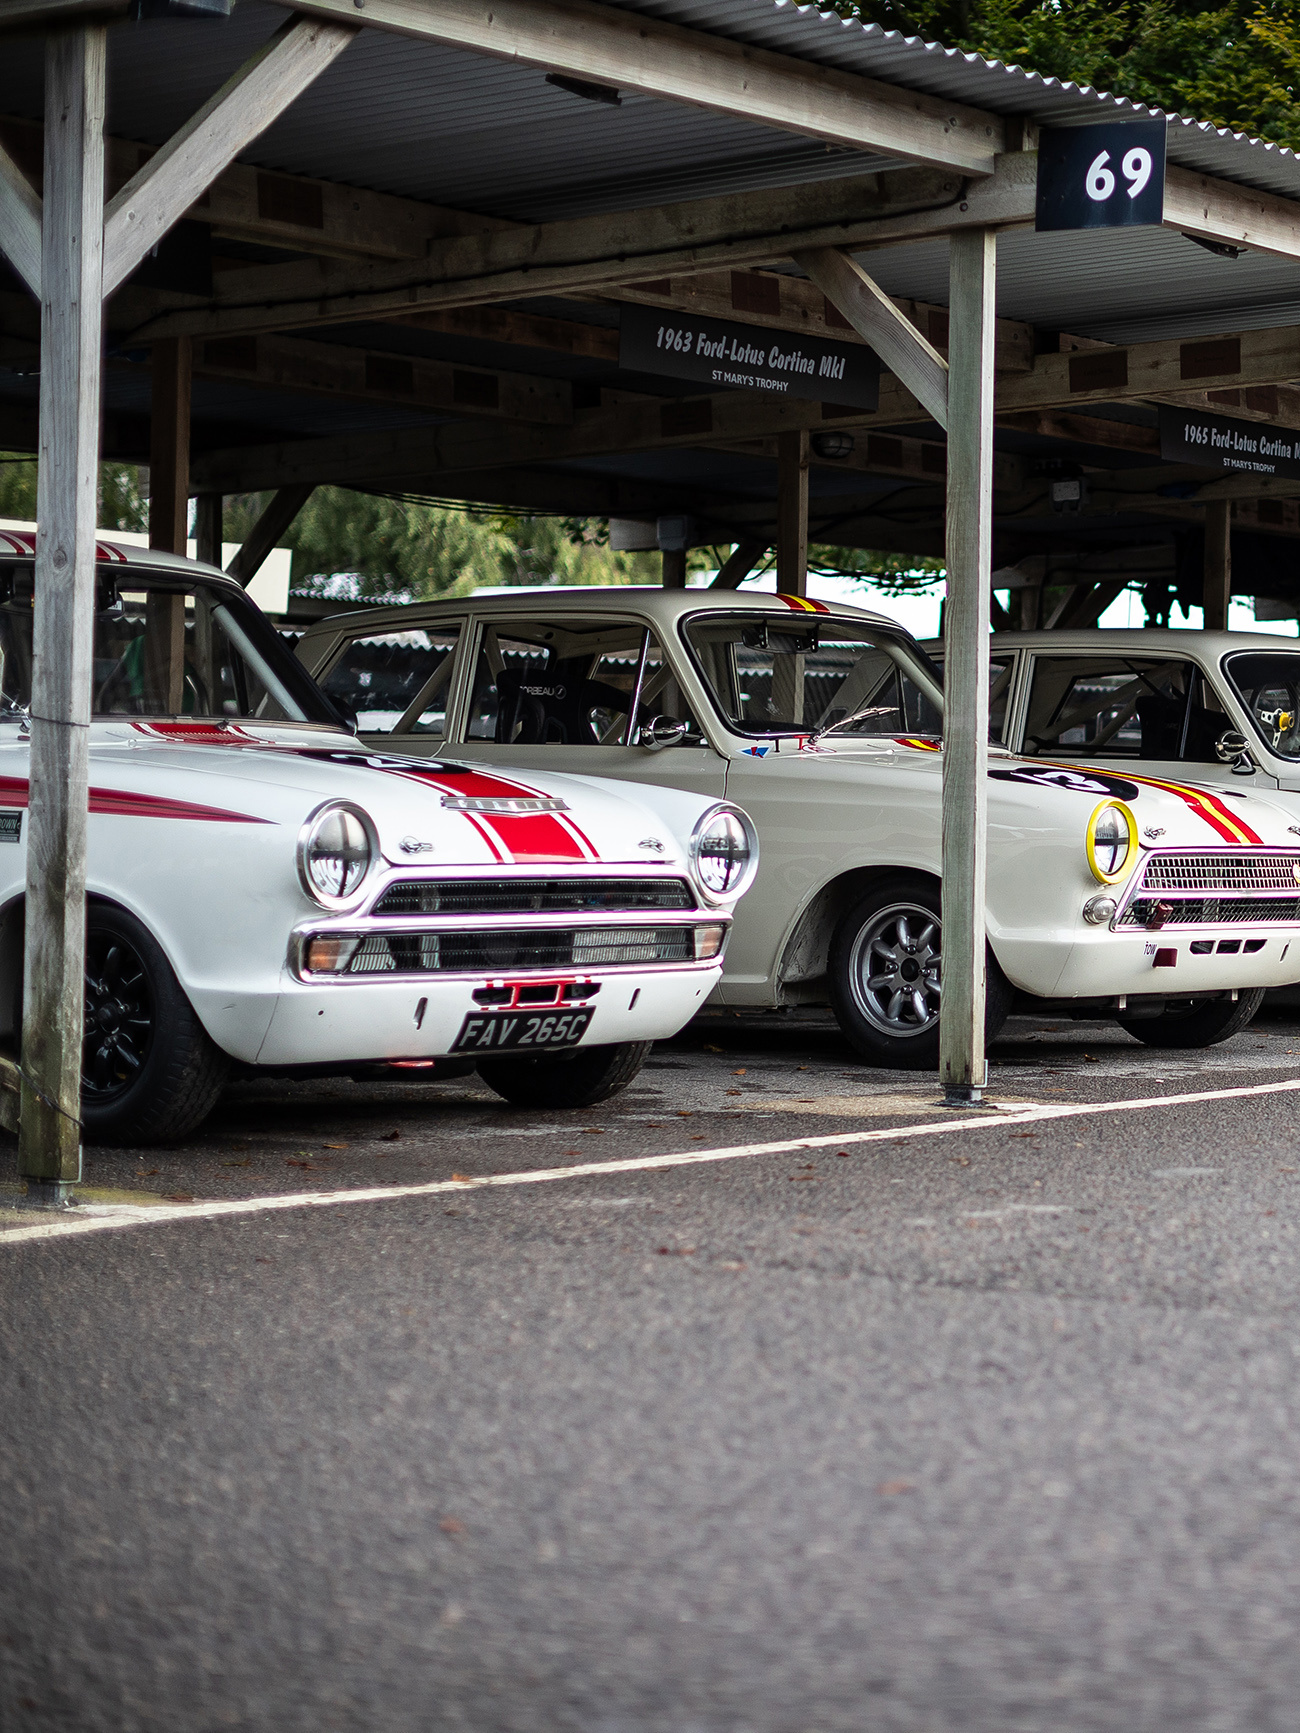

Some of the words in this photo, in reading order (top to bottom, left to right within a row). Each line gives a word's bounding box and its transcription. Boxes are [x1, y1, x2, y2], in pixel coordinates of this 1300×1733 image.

[1085, 147, 1152, 201] 69
[656, 326, 692, 353] 1963
[696, 332, 764, 367] Ford-Lotus
[768, 346, 815, 375] Cortina
[711, 369, 722, 381] ST
[724, 372, 754, 387] MARY'S
[755, 377, 789, 392] TROPHY
[1184, 423, 1208, 445] 1965
[1211, 427, 1257, 453] Ford-Lotus
[1259, 435, 1292, 459] Cortina
[1223, 457, 1231, 467] ST
[1231, 459, 1252, 470] MARY'S
[1252, 461, 1276, 473] TROPHY
[330, 752, 444, 769] 20
[1143, 943, 1157, 955] TOW
[459, 1018, 518, 1047] FAV
[517, 1014, 587, 1044] 265C
